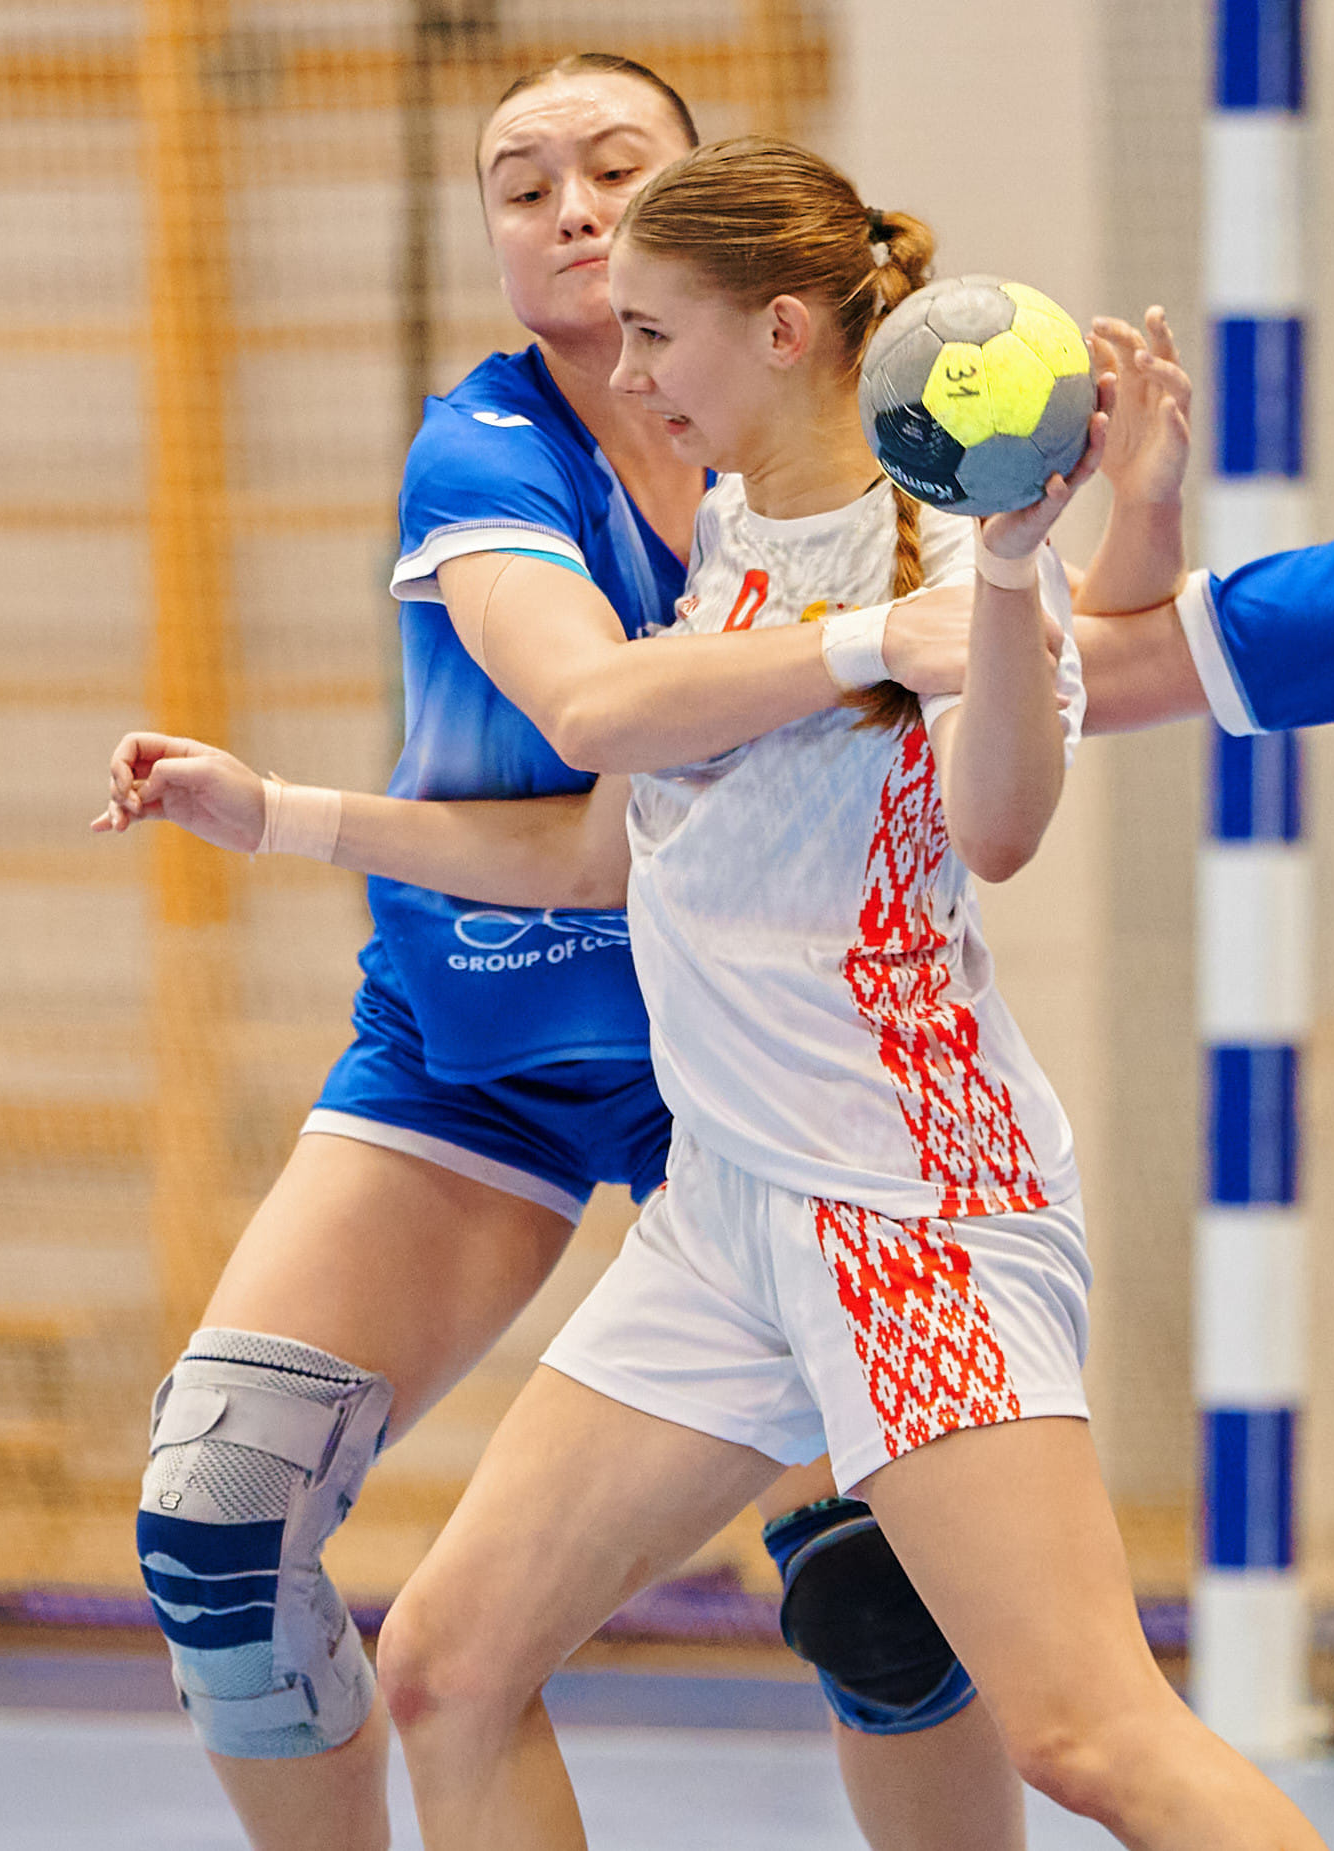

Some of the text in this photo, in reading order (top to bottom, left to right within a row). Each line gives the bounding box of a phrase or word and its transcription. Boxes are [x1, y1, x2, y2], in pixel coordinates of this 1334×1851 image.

[945, 365, 981, 399] 31
[447, 950, 541, 972] GROUP
[546, 938, 577, 964] OF
